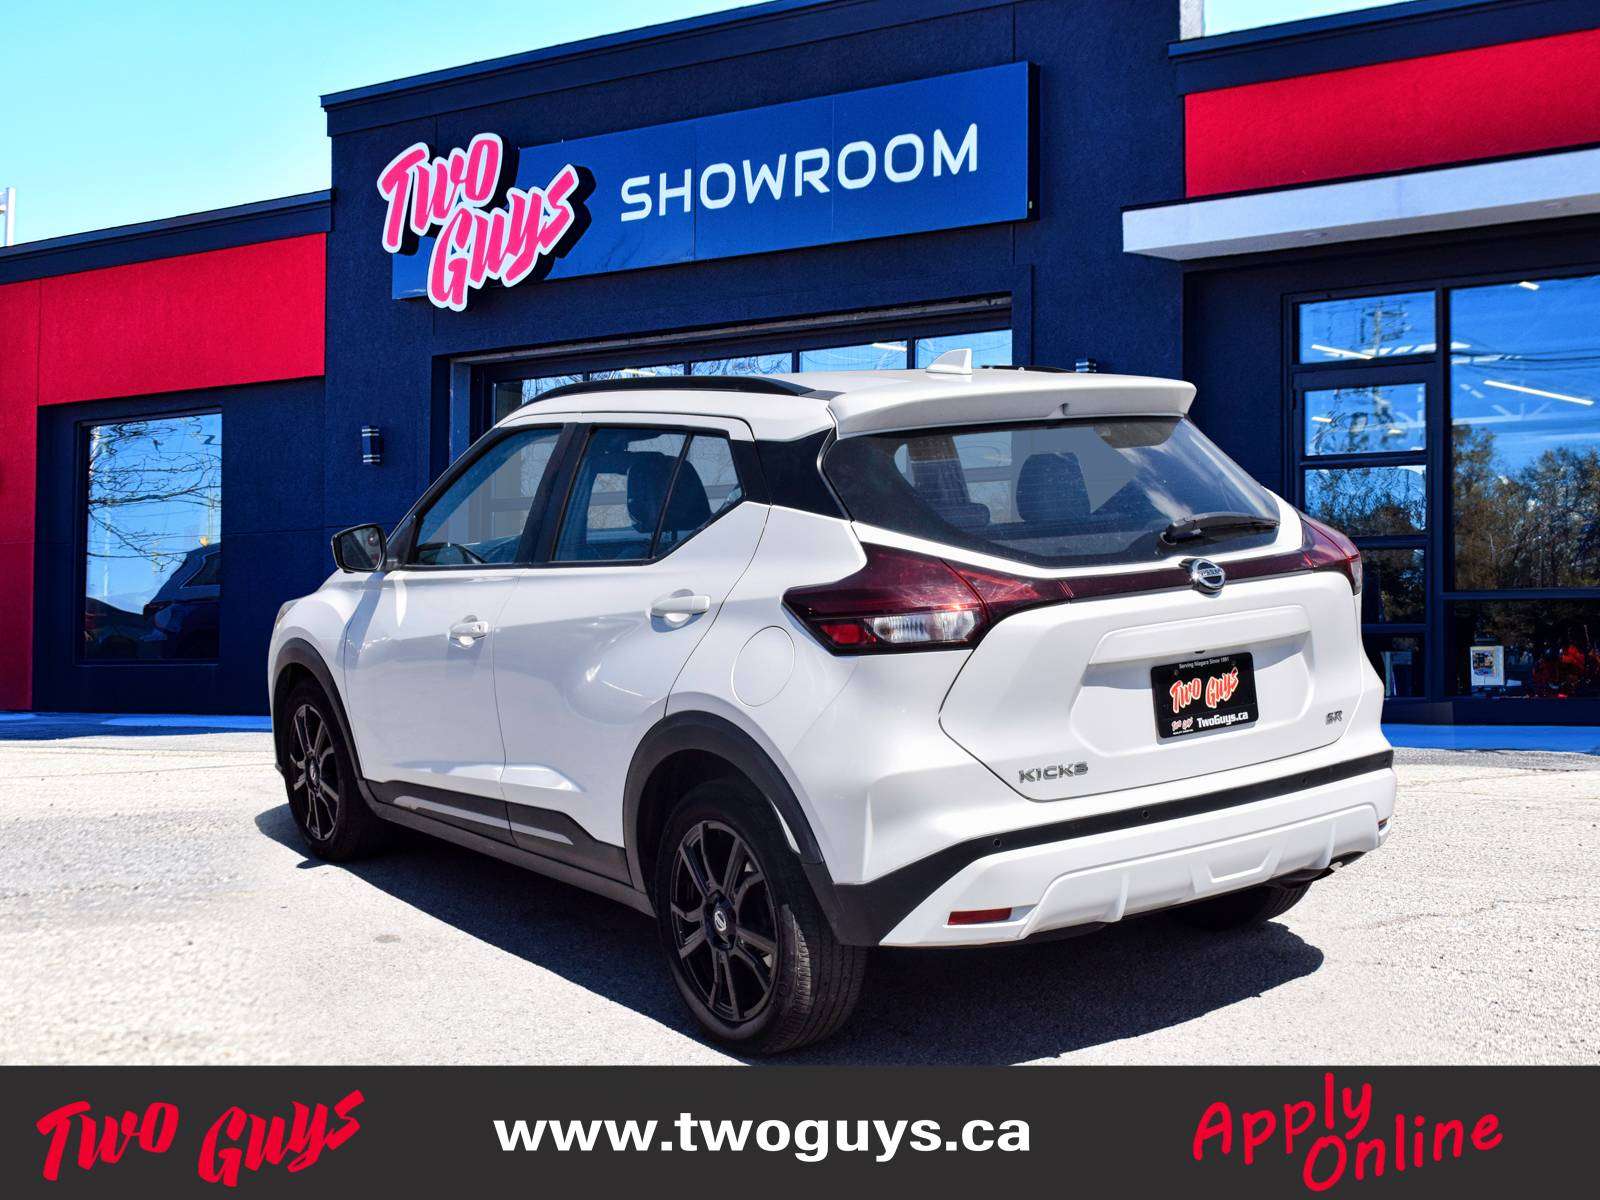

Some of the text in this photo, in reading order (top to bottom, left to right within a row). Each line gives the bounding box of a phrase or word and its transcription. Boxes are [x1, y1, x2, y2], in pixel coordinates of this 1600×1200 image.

[377, 133, 503, 253] Two
[621, 123, 978, 222] SHOWROOM
[427, 164, 579, 311] Guys
[1170, 667, 1238, 713] Two Guys
[1197, 711, 1248, 727] TwoGuys.ca
[1325, 710, 1342, 725] SR
[1019, 761, 1089, 784] KICKS
